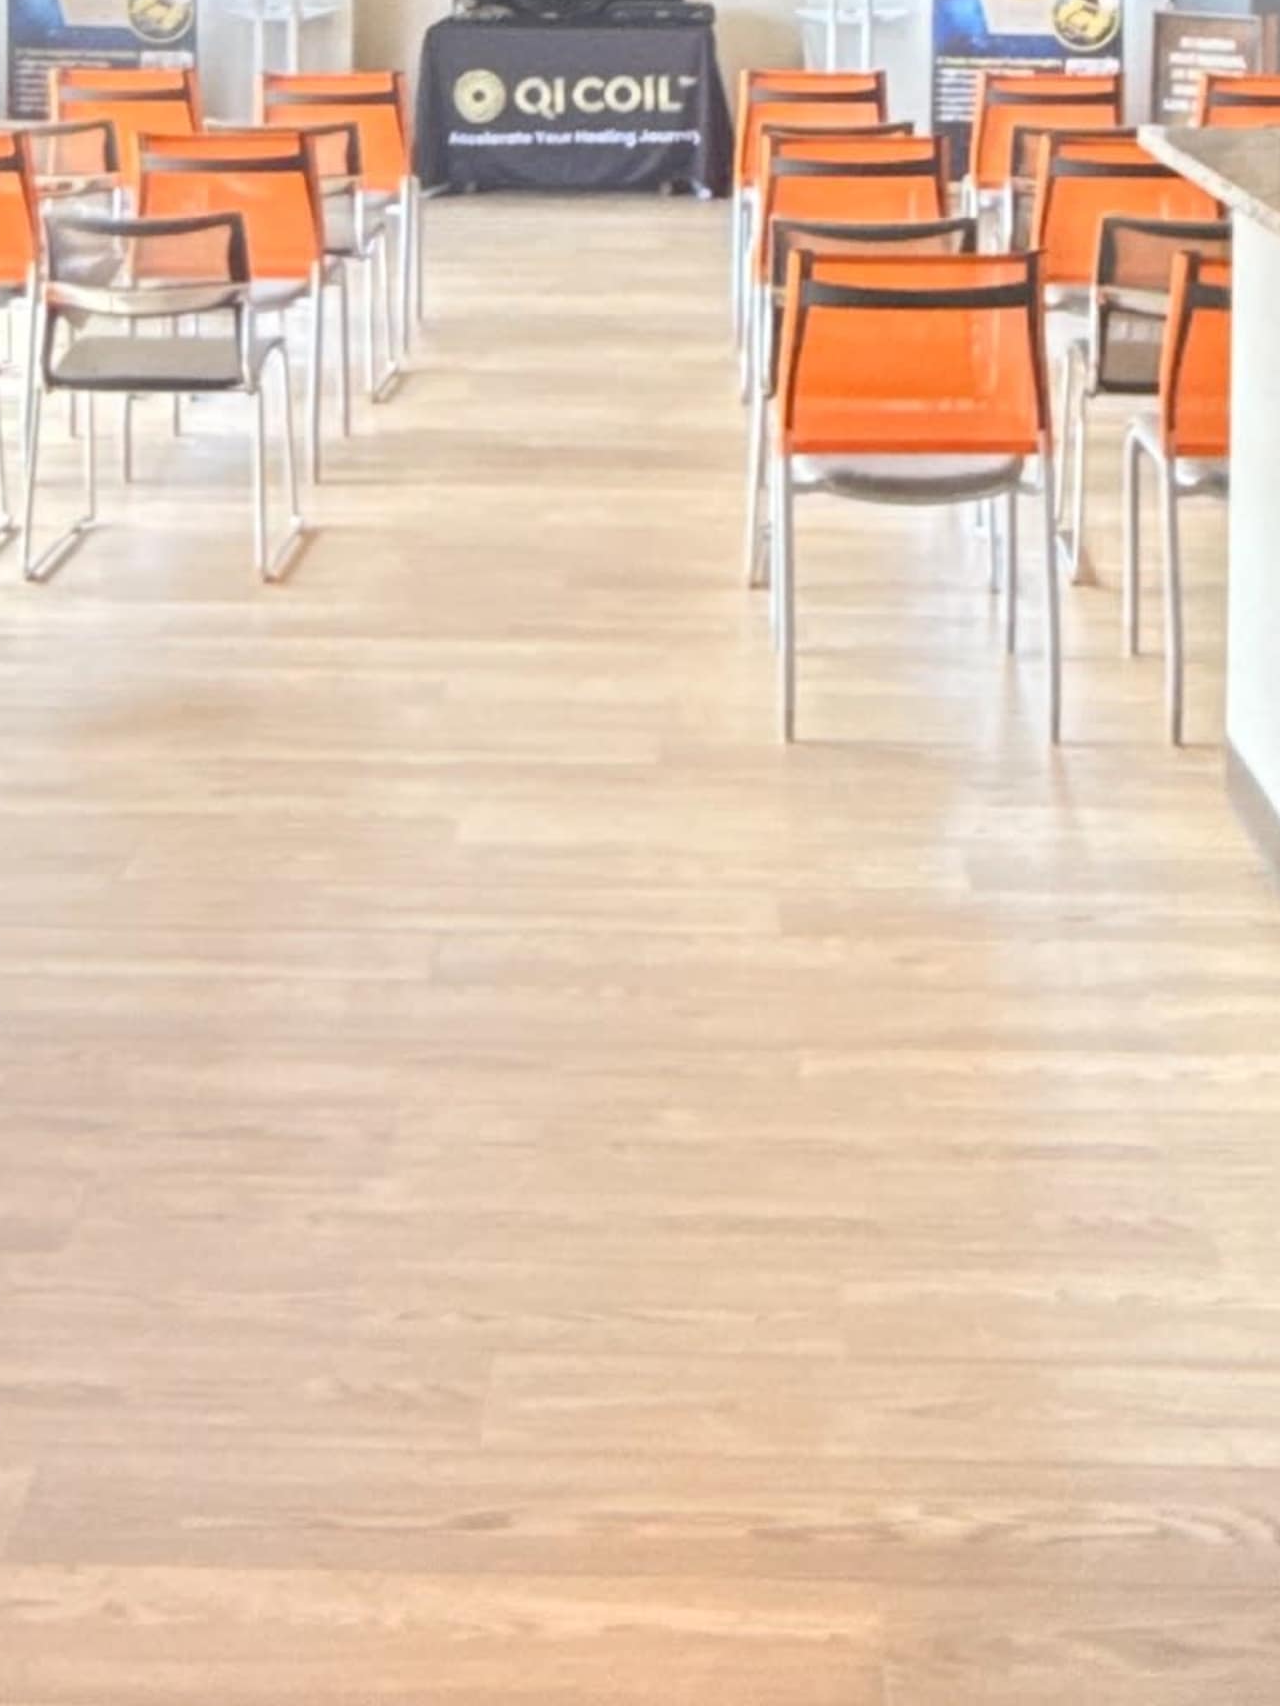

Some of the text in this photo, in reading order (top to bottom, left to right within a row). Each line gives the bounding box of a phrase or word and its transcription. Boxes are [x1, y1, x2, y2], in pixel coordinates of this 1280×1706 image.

[514, 75, 683, 120] QI COIL
[447, 128, 700, 149] Accelerate Your Healing Journey
